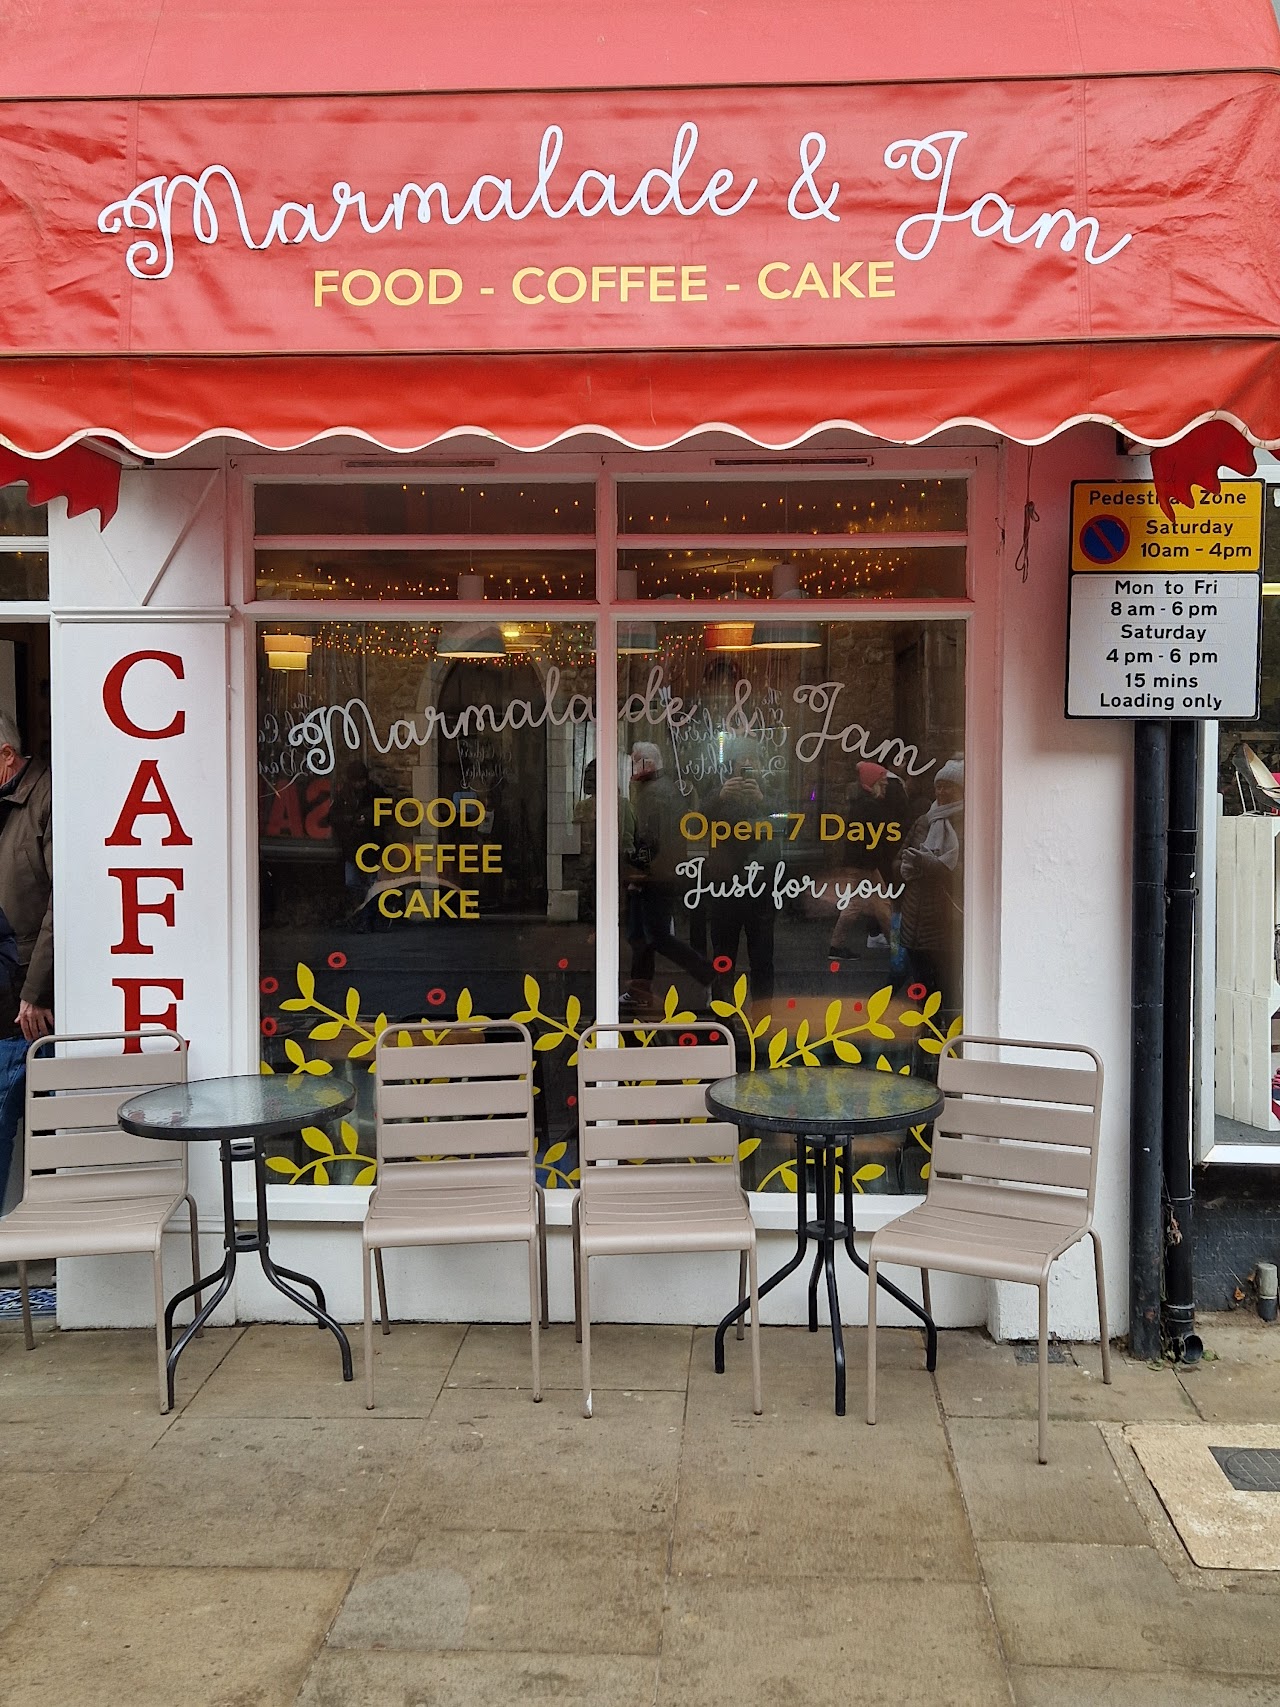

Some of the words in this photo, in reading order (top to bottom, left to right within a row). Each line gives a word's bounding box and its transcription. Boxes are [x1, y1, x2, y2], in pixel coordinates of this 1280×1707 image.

[98, 122, 758, 281] Marmalade
[787, 132, 841, 223] &
[884, 131, 1133, 265] Jam
[314, 269, 463, 307] FOOD
[512, 266, 708, 305] COFFEE
[757, 261, 896, 300] CAKE
[1089, 490, 1187, 506] Pedesta
[1200, 490, 1247, 505] Zone
[1146, 519, 1233, 538] Saturday
[1141, 543, 1189, 558] 10am
[1208, 543, 1252, 560] 4pm
[1115, 580, 1154, 595] Mon
[1165, 580, 1184, 595] to
[1194, 580, 1218, 595] Fri
[1121, 624, 1207, 643] Saturday
[1125, 673, 1146, 688] 15
[1153, 674, 1199, 688] mins
[1100, 693, 1175, 710] Loading
[1183, 693, 1223, 710] only
[793, 682, 937, 776] Jam
[373, 797, 487, 828] FOOD
[680, 812, 774, 849] Open
[788, 813, 806, 840] 7
[820, 813, 902, 850] Days
[102, 650, 193, 1055] CAFE
[355, 842, 503, 874] COFFEE
[675, 857, 766, 909] Just
[772, 861, 828, 910] for
[835, 878, 906, 911] you
[378, 889, 480, 919] CAKE
